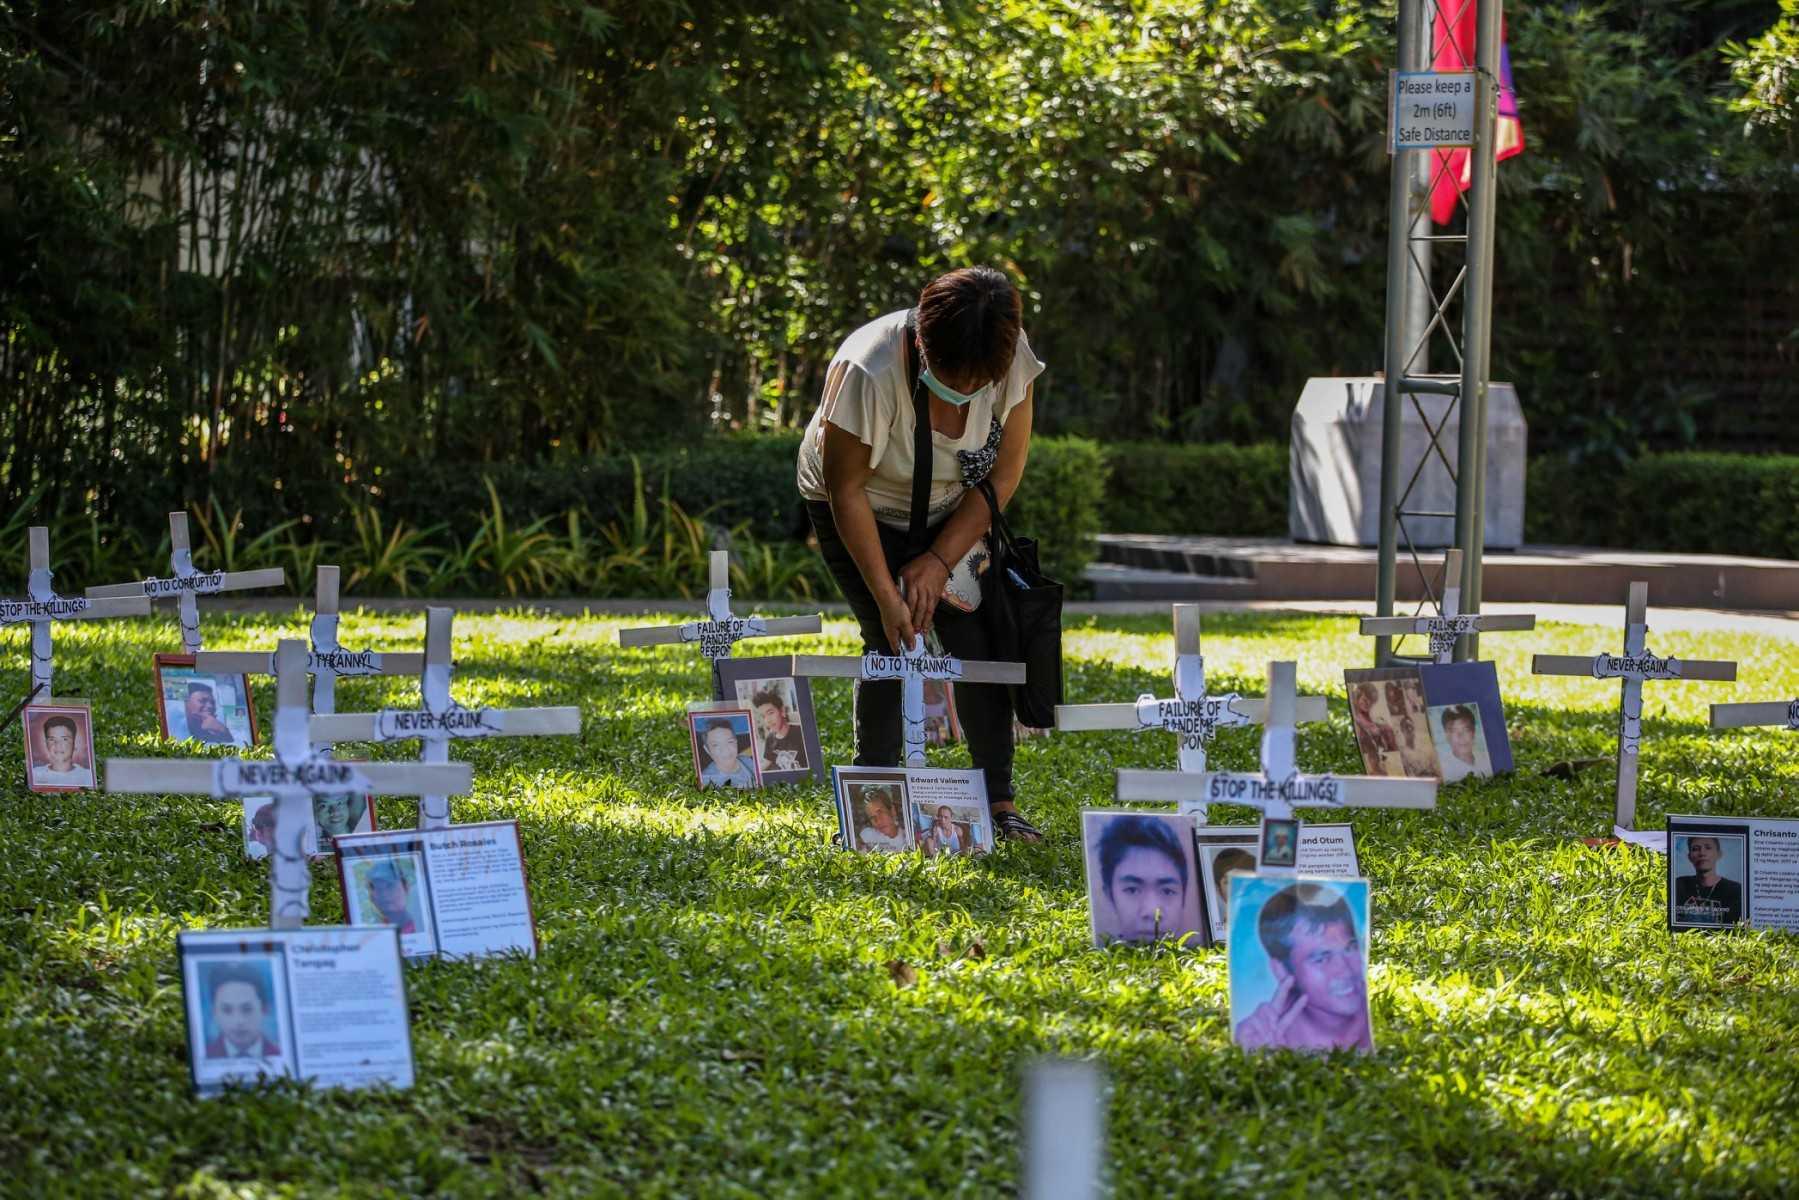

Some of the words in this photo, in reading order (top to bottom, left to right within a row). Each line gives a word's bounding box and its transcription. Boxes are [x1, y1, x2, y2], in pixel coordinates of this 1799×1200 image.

[1399, 80, 1432, 94] Please
[1435, 79, 1461, 95] keep
[1464, 82, 1471, 93] a
[1413, 104, 1430, 118] 2m
[1433, 102, 1456, 119] (6ft)
[1400, 127, 1421, 141] Safe
[1424, 127, 1470, 141] Distance
[145, 582, 157, 592] NO
[159, 580, 170, 591] TO
[0, 603, 22, 616] STOP
[25, 602, 41, 615] THE
[697, 621, 731, 635] FAILURE
[733, 620, 744, 632] OF
[316, 653, 371, 668] TYRANNY!
[871, 657, 885, 671] NO
[889, 657, 902, 671] TO
[905, 657, 952, 672] TYRANNY!
[1607, 658, 1635, 671] NEVER
[1160, 700, 1203, 717] FAILURE
[1207, 700, 1221, 716] OF
[395, 712, 433, 730] NEVER
[239, 763, 287, 785] NEVER
[911, 776, 938, 784] Edward
[940, 777, 970, 785] Valiente
[1211, 779, 1247, 798] STOP
[1251, 780, 1275, 799] THE
[1279, 780, 1338, 801] KILLINGS!
[1320, 836, 1344, 844] Otum
[1754, 829, 1798, 838] Chrisanto
